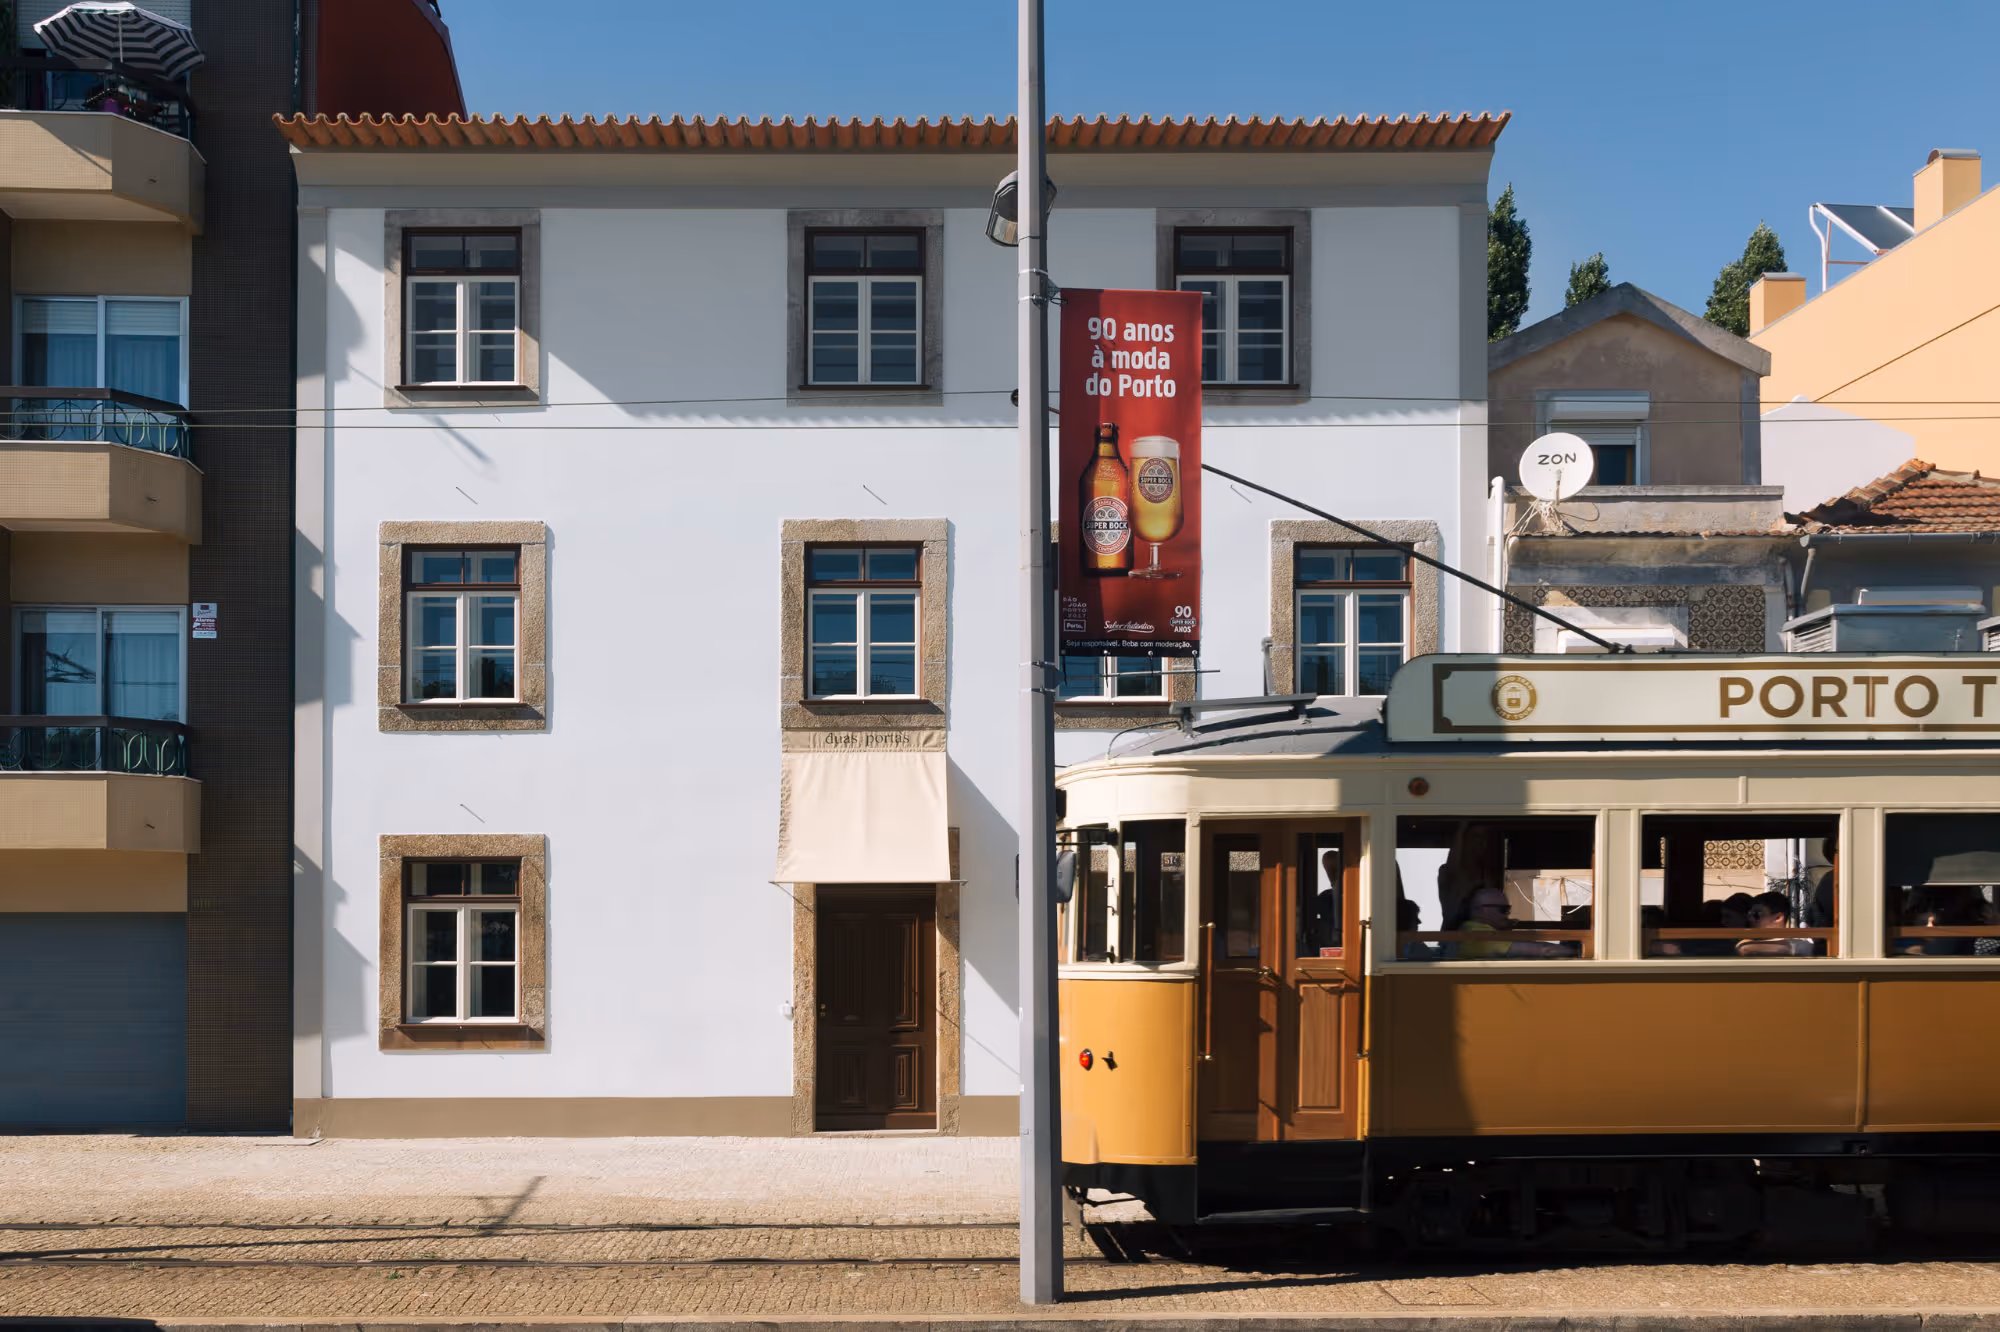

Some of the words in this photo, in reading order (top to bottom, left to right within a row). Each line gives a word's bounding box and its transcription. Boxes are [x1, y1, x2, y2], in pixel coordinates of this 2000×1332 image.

[1087, 317, 1117, 341] 90
[1123, 322, 1175, 343] anos
[1091, 345, 1105, 369] à
[1111, 346, 1171, 370] moda
[1085, 372, 1112, 396] do
[1118, 374, 1176, 398] Porto
[1537, 452, 1577, 466] ZON
[1086, 521, 1108, 530] SUPER
[1109, 521, 1128, 530] BOCK
[1174, 605, 1192, 618] 90
[1121, 640, 1139, 648] Beba
[1155, 640, 1192, 649] moderação.
[1719, 675, 1939, 719] PORTO
[825, 732, 858, 745] duas
[864, 733, 910, 746] portas
